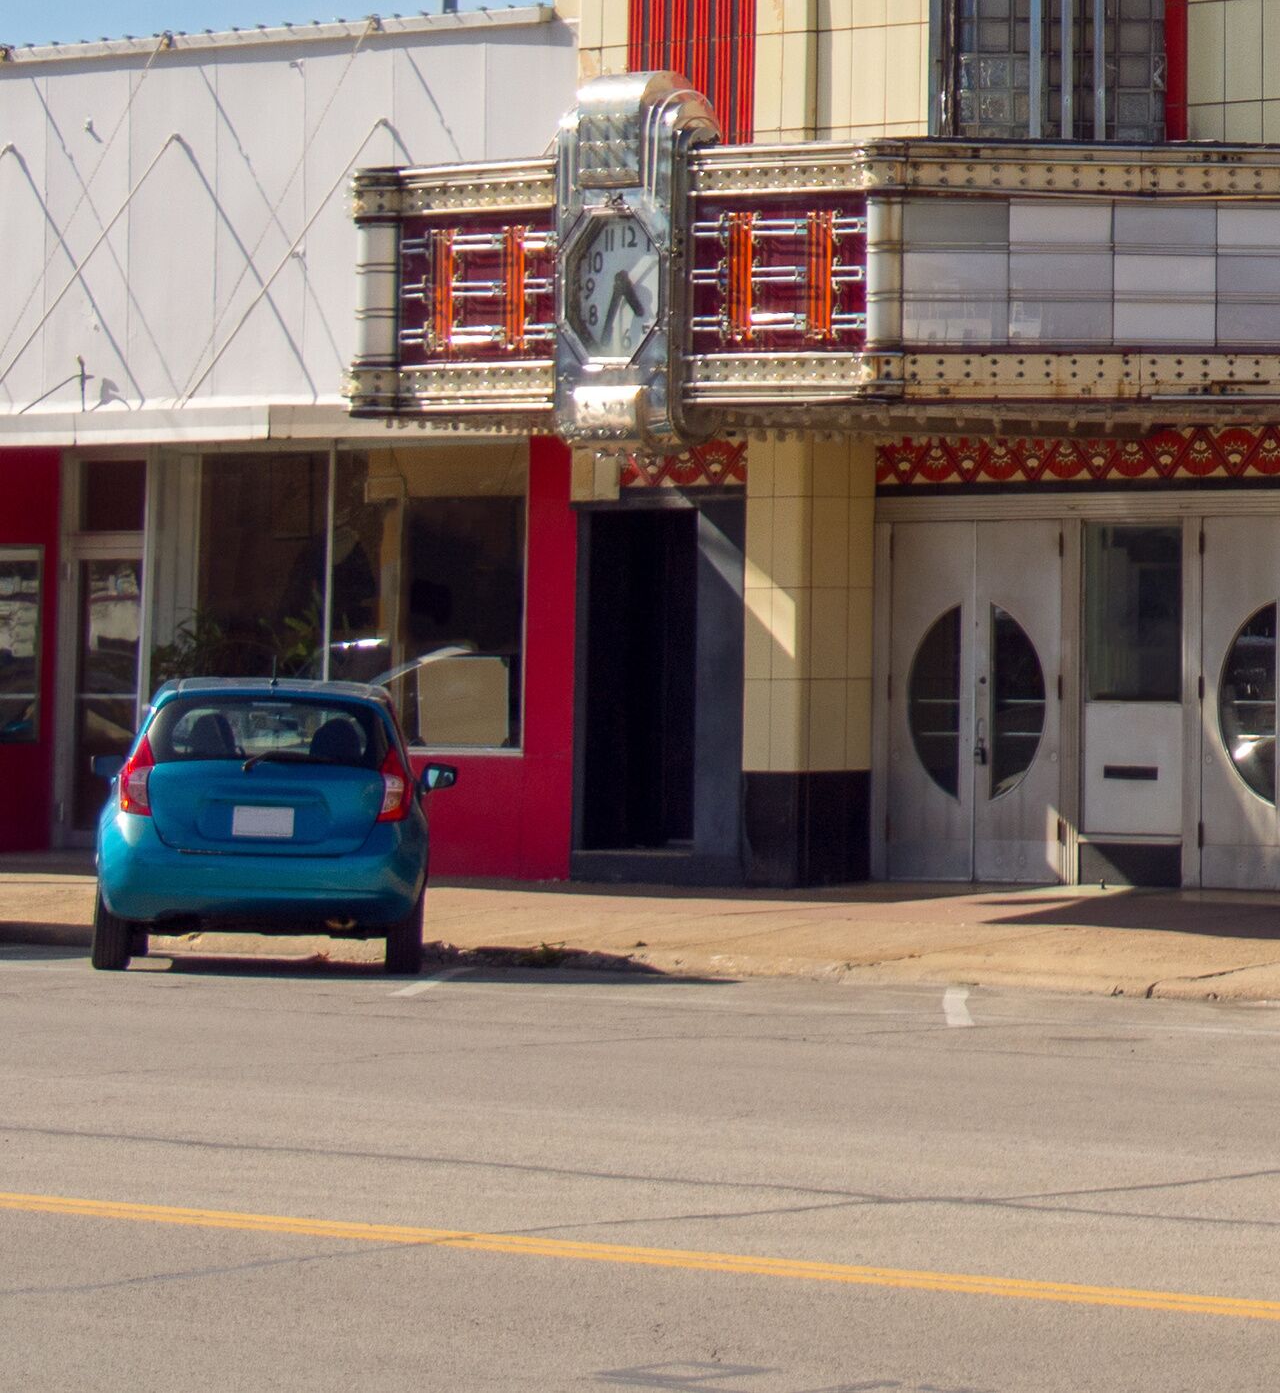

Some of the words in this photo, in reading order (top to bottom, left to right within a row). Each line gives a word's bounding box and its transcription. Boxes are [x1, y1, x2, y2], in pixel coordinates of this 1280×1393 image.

[605, 228, 615, 252] 11
[622, 225, 637, 248] 12
[588, 251, 603, 274] 10
[585, 277, 596, 300] 9
[588, 305, 598, 327] 8
[621, 328, 632, 350] 6
